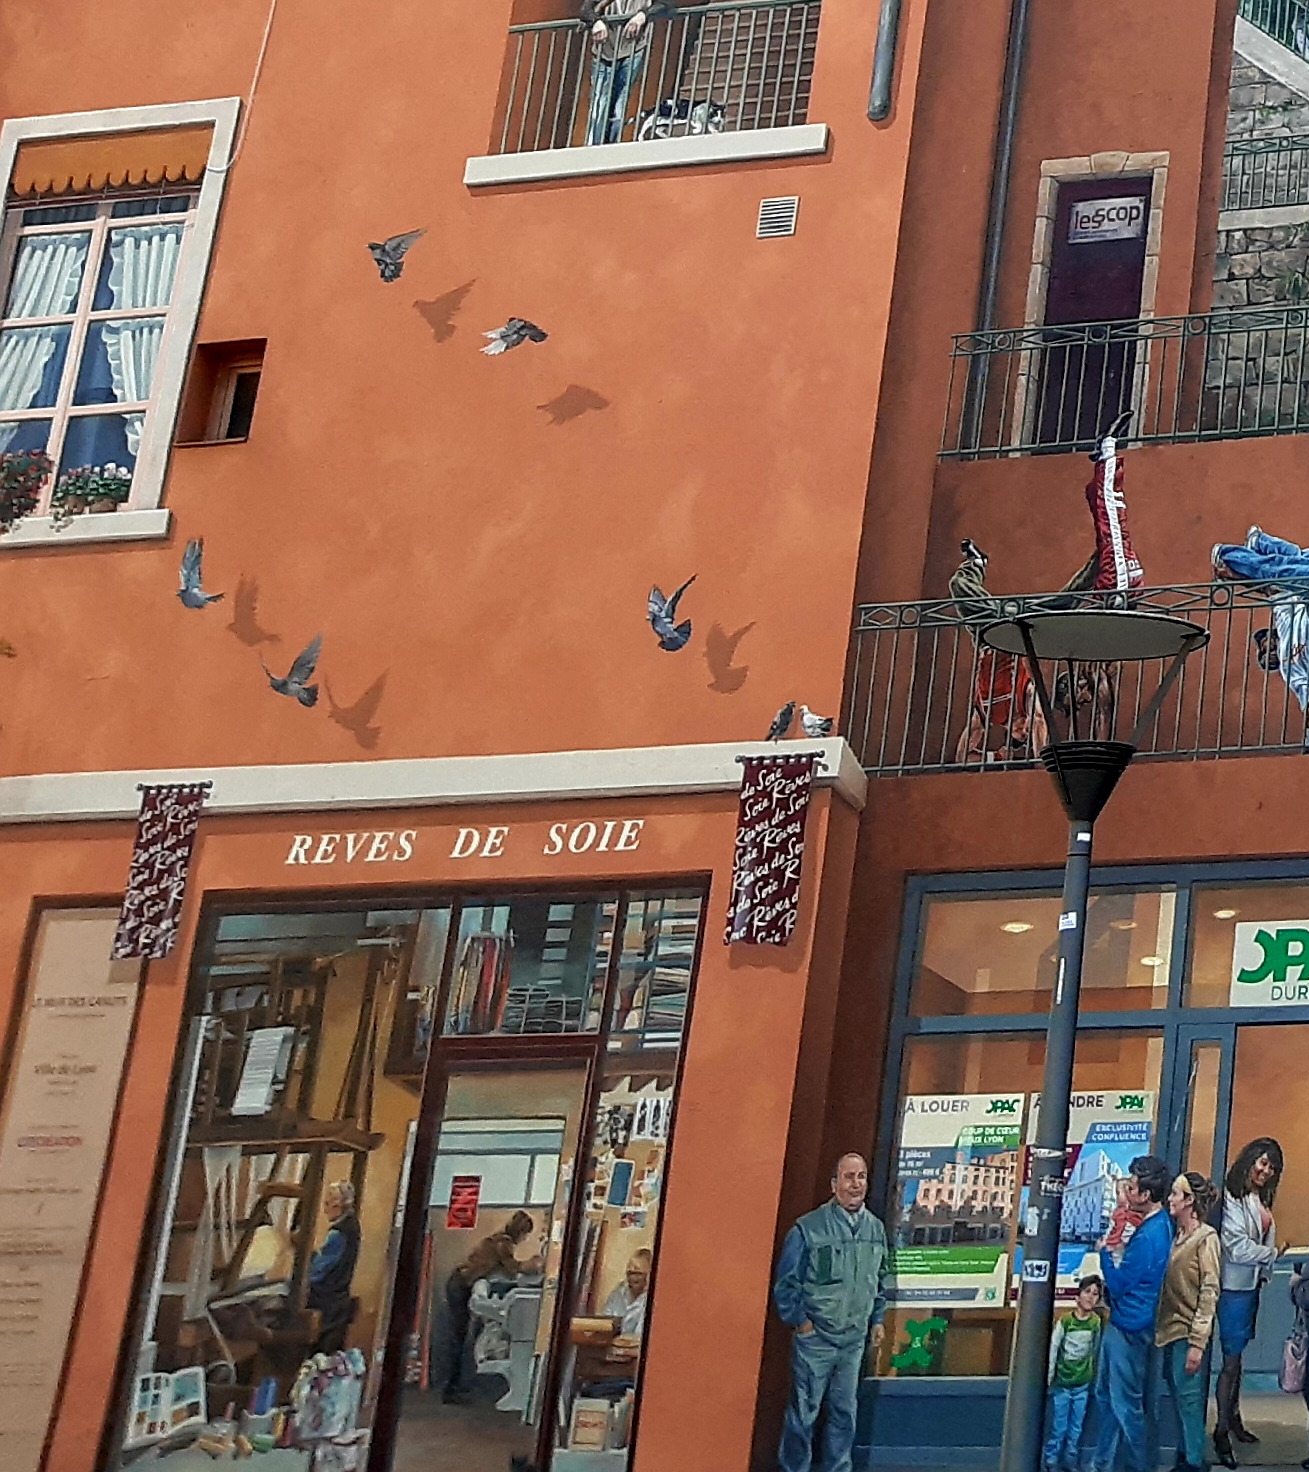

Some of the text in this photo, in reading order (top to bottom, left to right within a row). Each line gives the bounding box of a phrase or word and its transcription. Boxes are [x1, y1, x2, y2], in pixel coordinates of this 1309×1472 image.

[284, 818, 645, 865] REVES DE SOIE
[920, 1099, 970, 1114] LOUER
